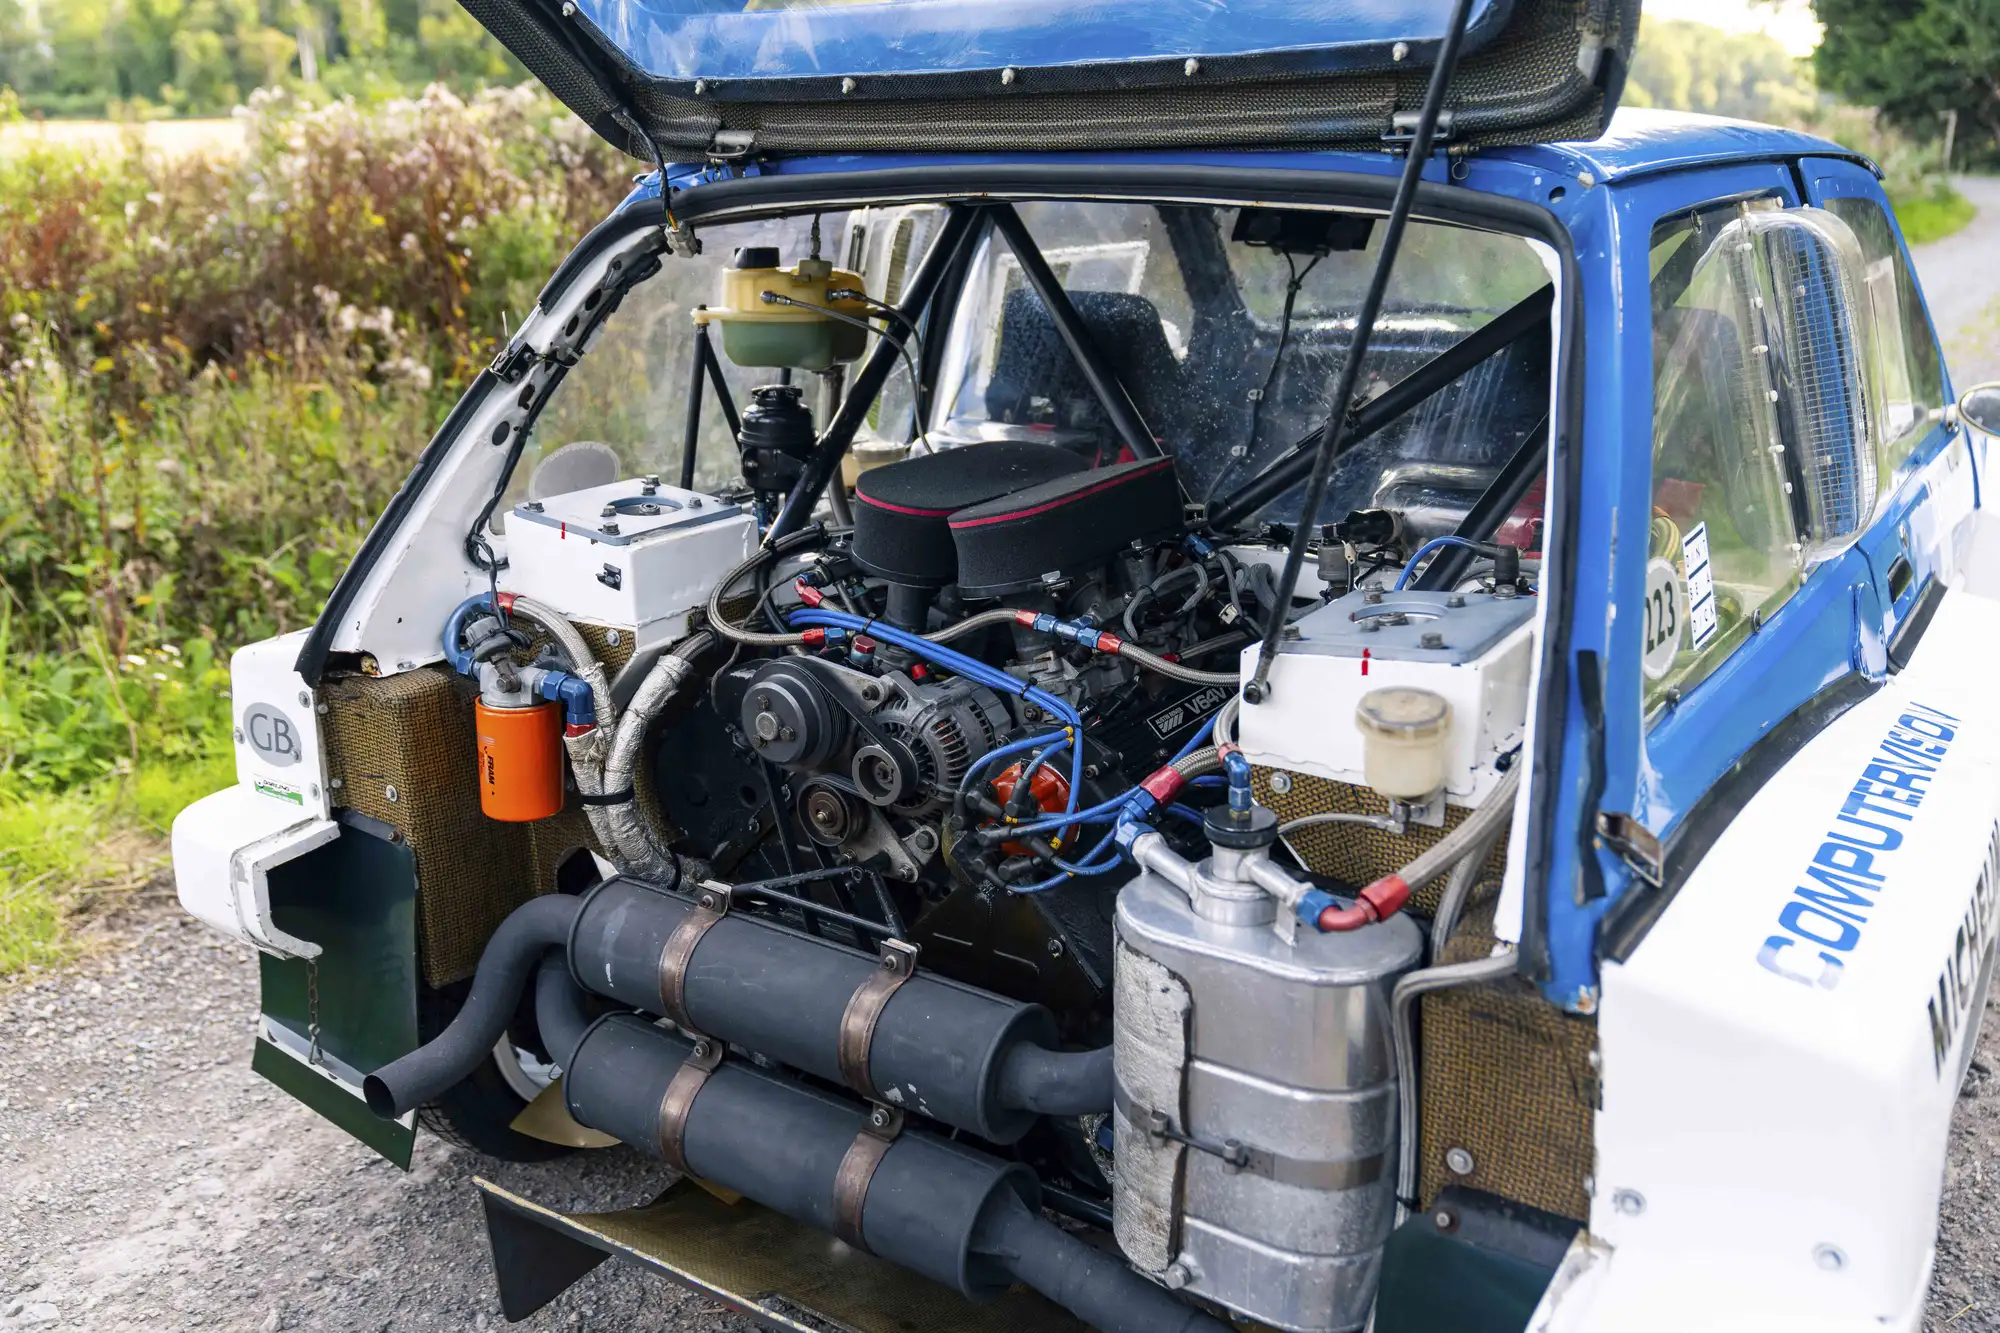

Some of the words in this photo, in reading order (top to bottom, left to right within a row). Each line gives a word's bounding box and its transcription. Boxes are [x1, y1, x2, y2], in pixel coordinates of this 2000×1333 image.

[1645, 581, 1675, 655] 223
[1184, 687, 1228, 715] V64V
[250, 712, 294, 754] GB
[487, 755, 495, 785] FRAM
[1756, 701, 1962, 991] COMPUTERVISION
